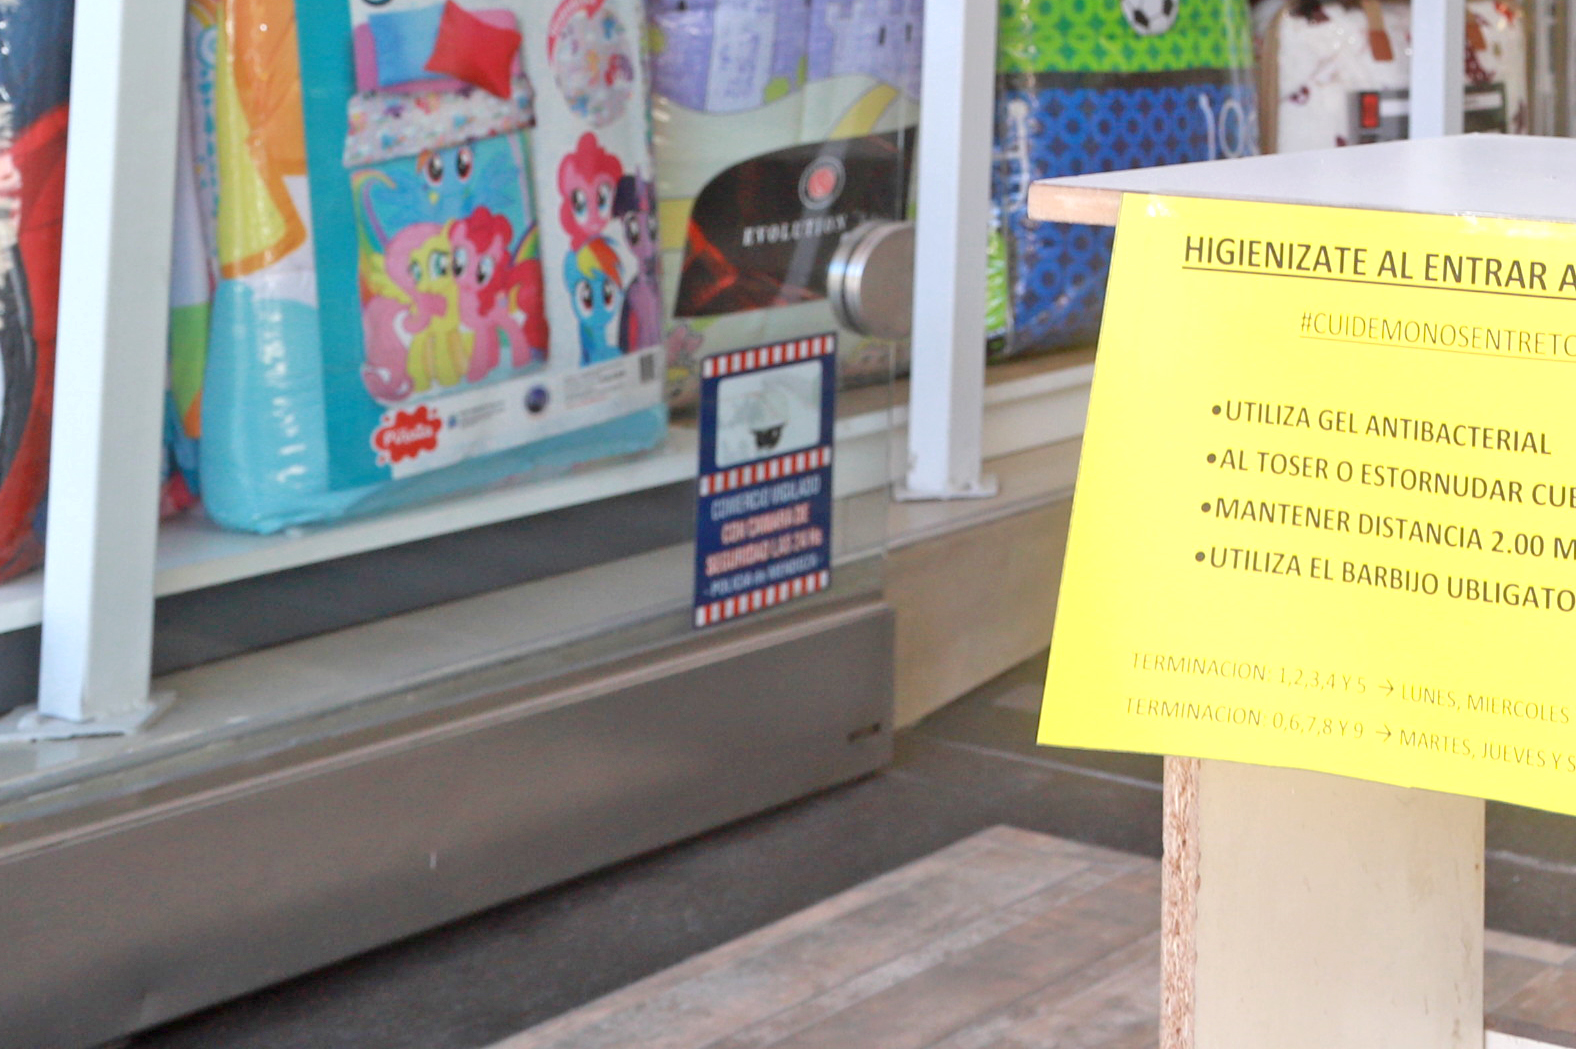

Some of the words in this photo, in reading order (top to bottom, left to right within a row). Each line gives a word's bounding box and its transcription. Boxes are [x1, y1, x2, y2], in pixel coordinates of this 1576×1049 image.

[742, 212, 848, 247] EVOLUTION
[1185, 235, 1367, 277] HIGIENIZATE
[1377, 248, 1414, 281] AL
[1424, 253, 1547, 290] ENTRAR
[1225, 400, 1311, 428] UTILIZA
[1318, 409, 1358, 435] GEL
[1365, 414, 1552, 456] ANTIBACTERIAL
[1220, 449, 1249, 471] AL
[1256, 451, 1328, 480] TOSER
[1336, 460, 1353, 483] O
[1360, 463, 1524, 503] ESTORNUDAR
[711, 489, 768, 521] COMERCIO
[1215, 497, 1350, 532] MANTENER
[1359, 513, 1483, 550] DISTANCIA
[1491, 530, 1544, 557] 2.00
[1210, 547, 1302, 577] UTILIZA
[1310, 557, 1334, 581] EL
[1342, 561, 1439, 596] BARBIJO
[1131, 652, 1272, 683] TERMINACION:
[1341, 672, 1354, 691] Y
[1356, 675, 1367, 694] 5
[1401, 683, 1464, 712] LUNES,
[1467, 694, 1570, 725] MIERCOLES
[1125, 697, 1267, 729] TERMINACION:
[1337, 719, 1350, 737] Y
[1353, 721, 1364, 740] 9
[1400, 729, 1476, 759] MARTES,
[1480, 740, 1546, 770] JUEVES
[1551, 752, 1564, 770] Y
